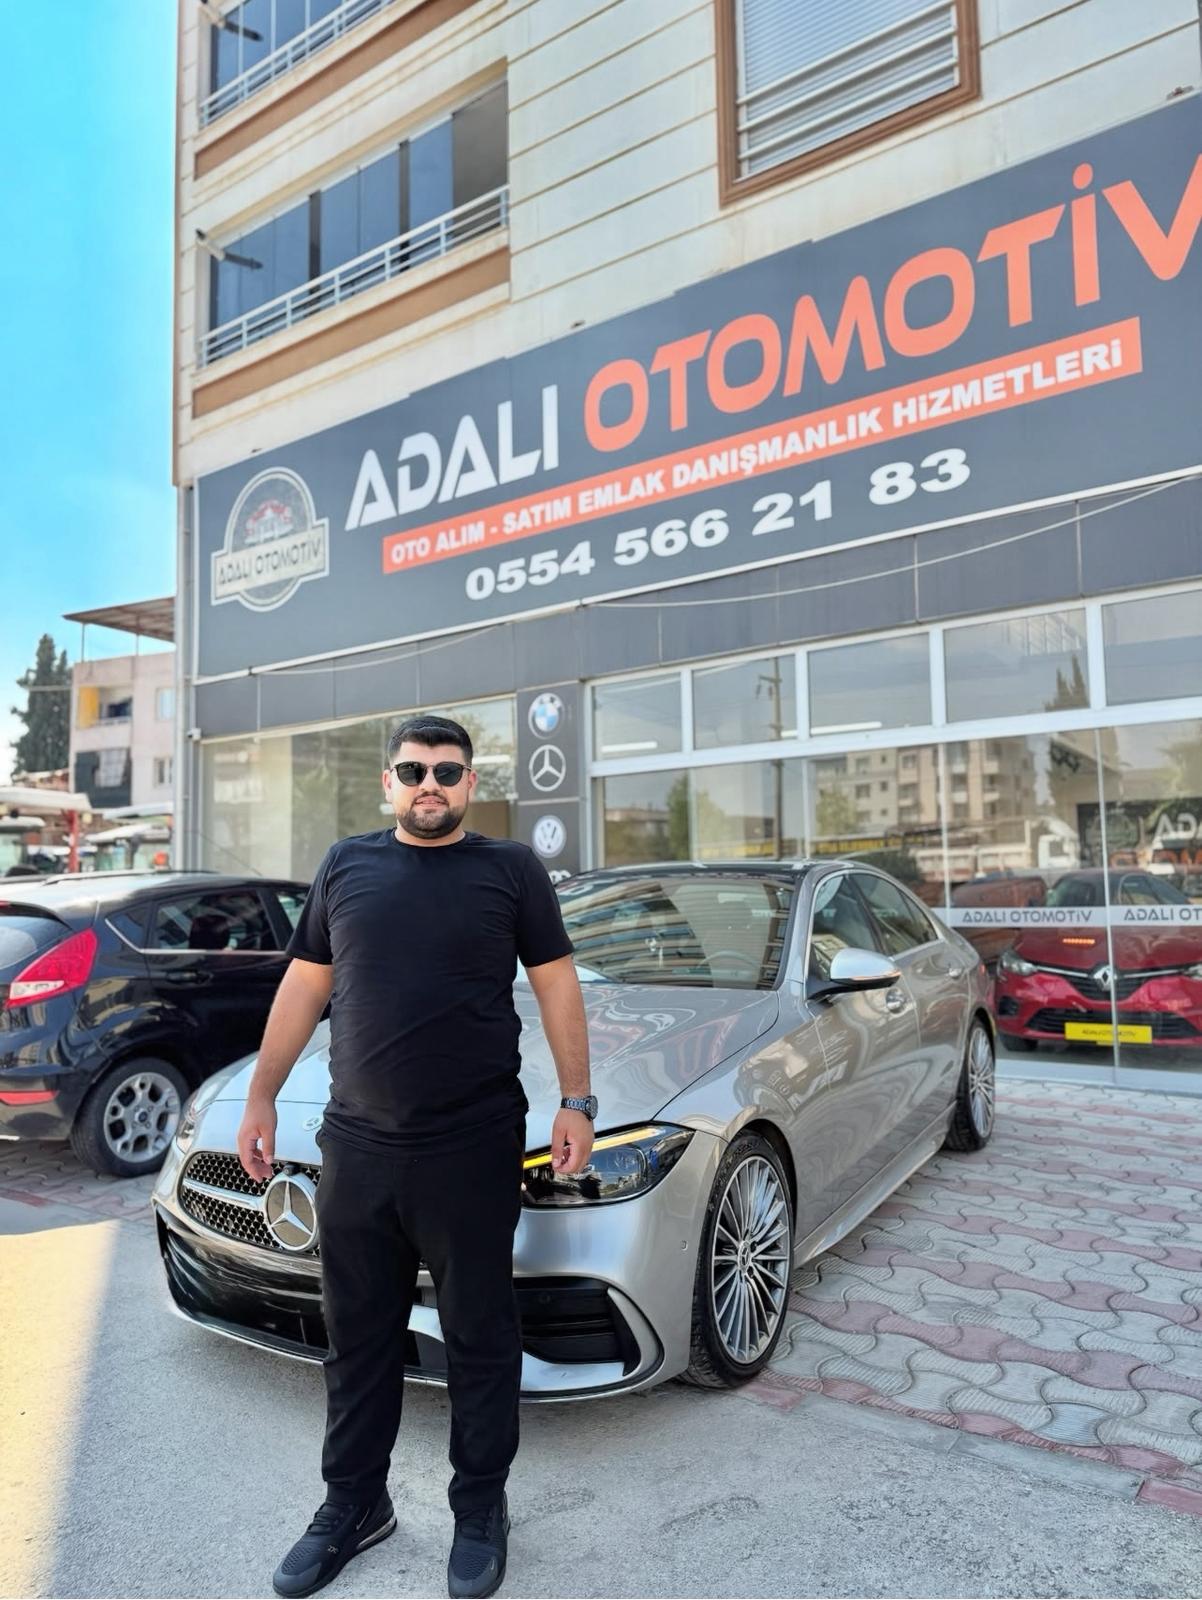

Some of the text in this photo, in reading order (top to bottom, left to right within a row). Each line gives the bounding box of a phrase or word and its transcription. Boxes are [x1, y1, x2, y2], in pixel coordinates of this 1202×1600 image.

[345, 155, 1202, 531] ADALI OTOMOTİV
[391, 536, 431, 565] OTO
[434, 520, 486, 554] ALIM
[502, 496, 571, 534] SATIM
[578, 469, 666, 514] EMLAK
[671, 407, 883, 489] DANIŞMANLIK
[465, 448, 971, 601] 0554 566 21 83
[962, 911, 1006, 923] ADALI
[1123, 908, 1174, 921] ADALI
